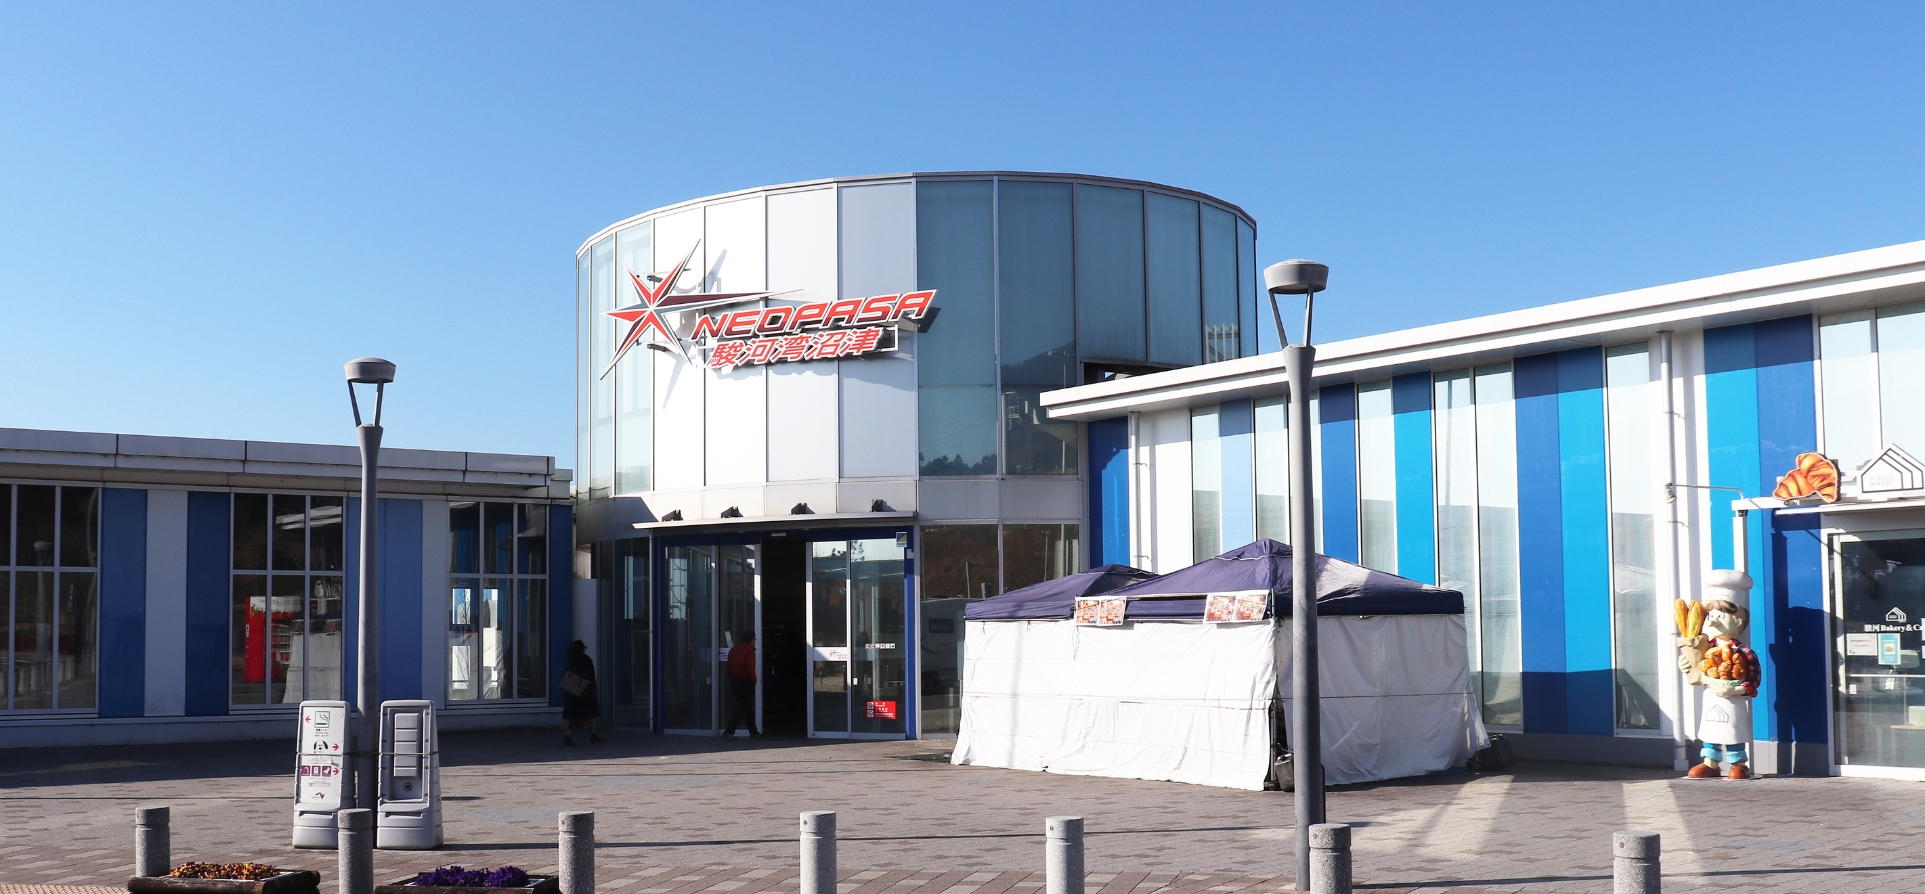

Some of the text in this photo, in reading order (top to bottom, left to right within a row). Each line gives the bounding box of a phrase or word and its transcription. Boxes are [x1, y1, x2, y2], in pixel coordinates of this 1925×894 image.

[688, 289, 938, 342] NEOPASA
[706, 326, 885, 368] 駿河湾沼津
